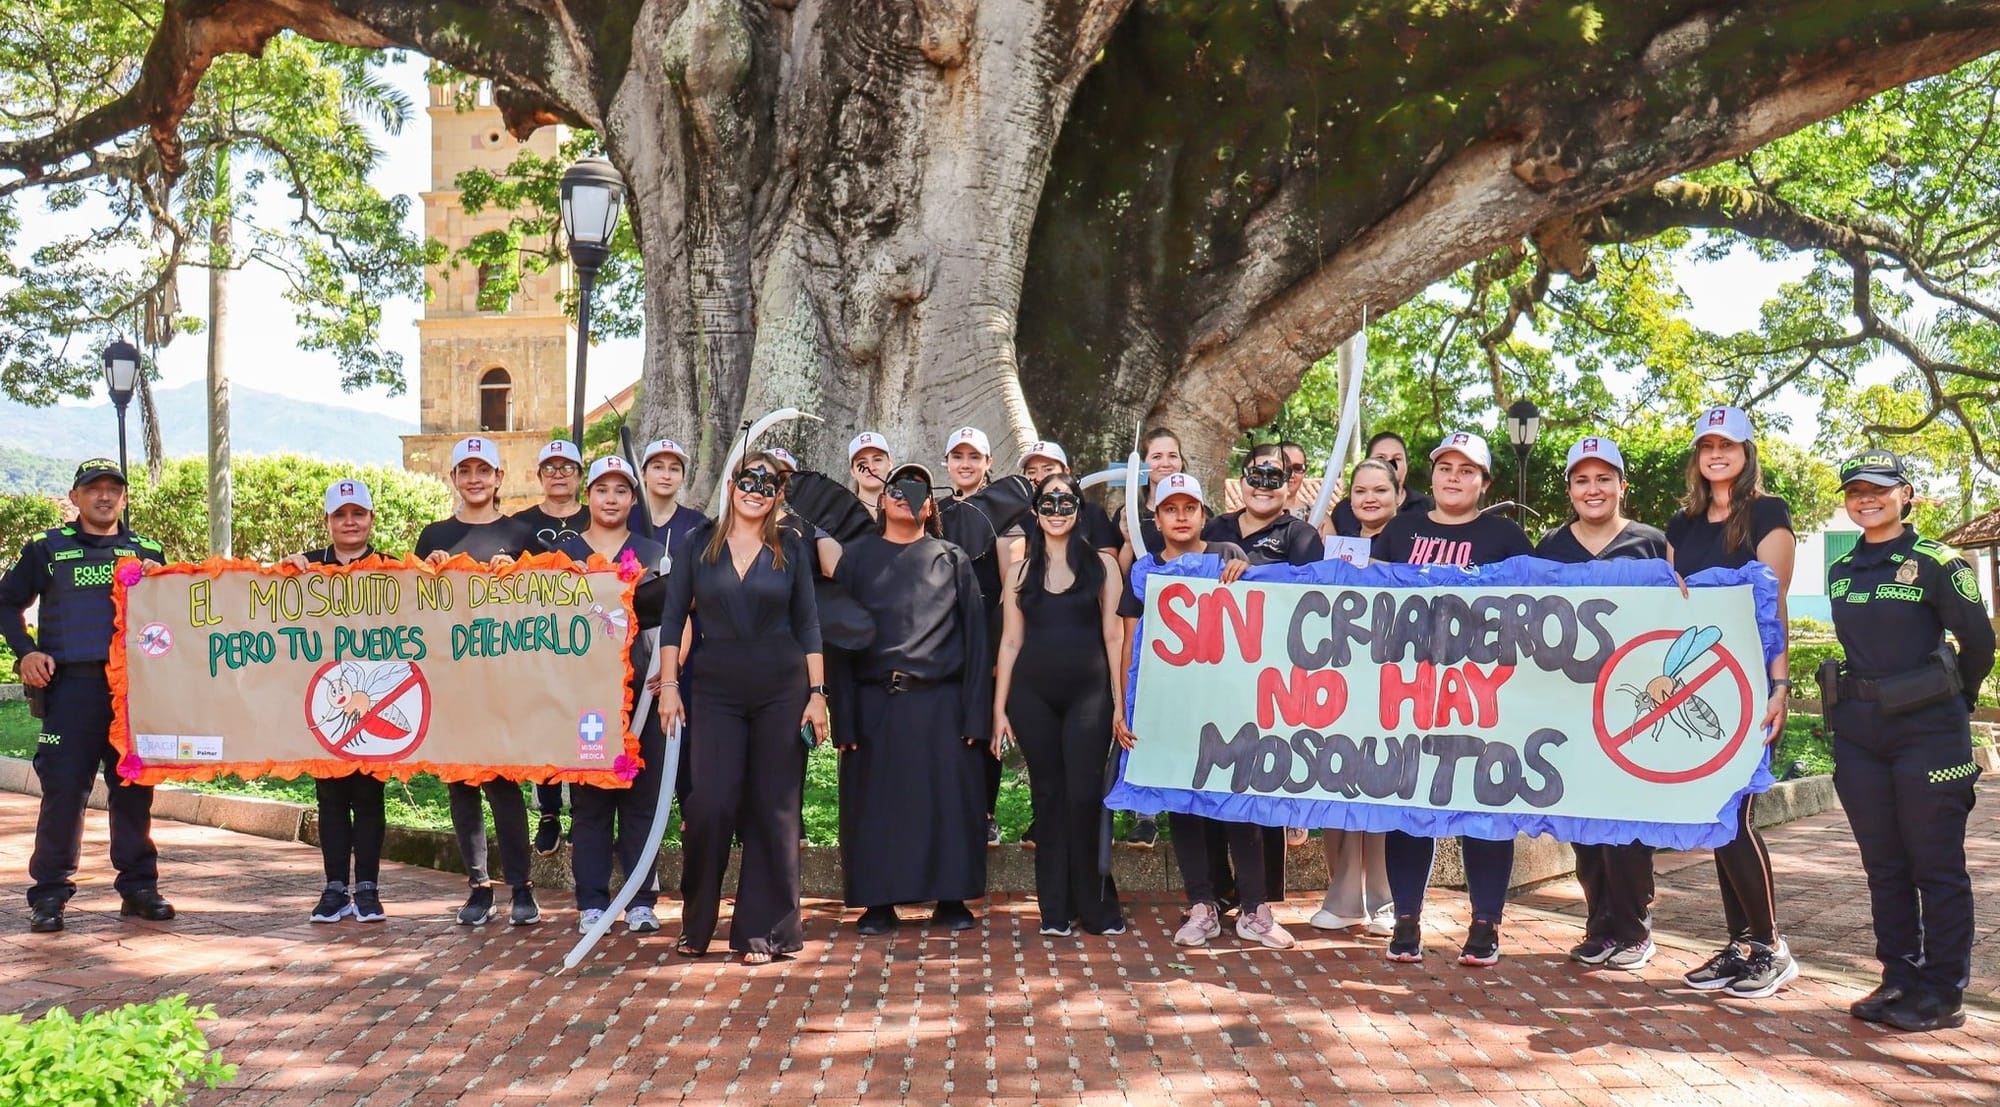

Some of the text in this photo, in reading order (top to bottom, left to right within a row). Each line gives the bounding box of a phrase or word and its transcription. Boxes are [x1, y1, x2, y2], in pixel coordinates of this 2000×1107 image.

[74, 560, 115, 578] POLICÍ
[1408, 538, 1472, 567] HELLO
[189, 571, 594, 627] EL MOSQUITO NO DESCANSA
[209, 613, 591, 678] PERO TU PUEDES DETENERLO
[1152, 583, 1618, 684] SIN CRIADEROS
[1257, 658, 1515, 730] NO HAY
[1192, 721, 1569, 808] MOSQUITOS
